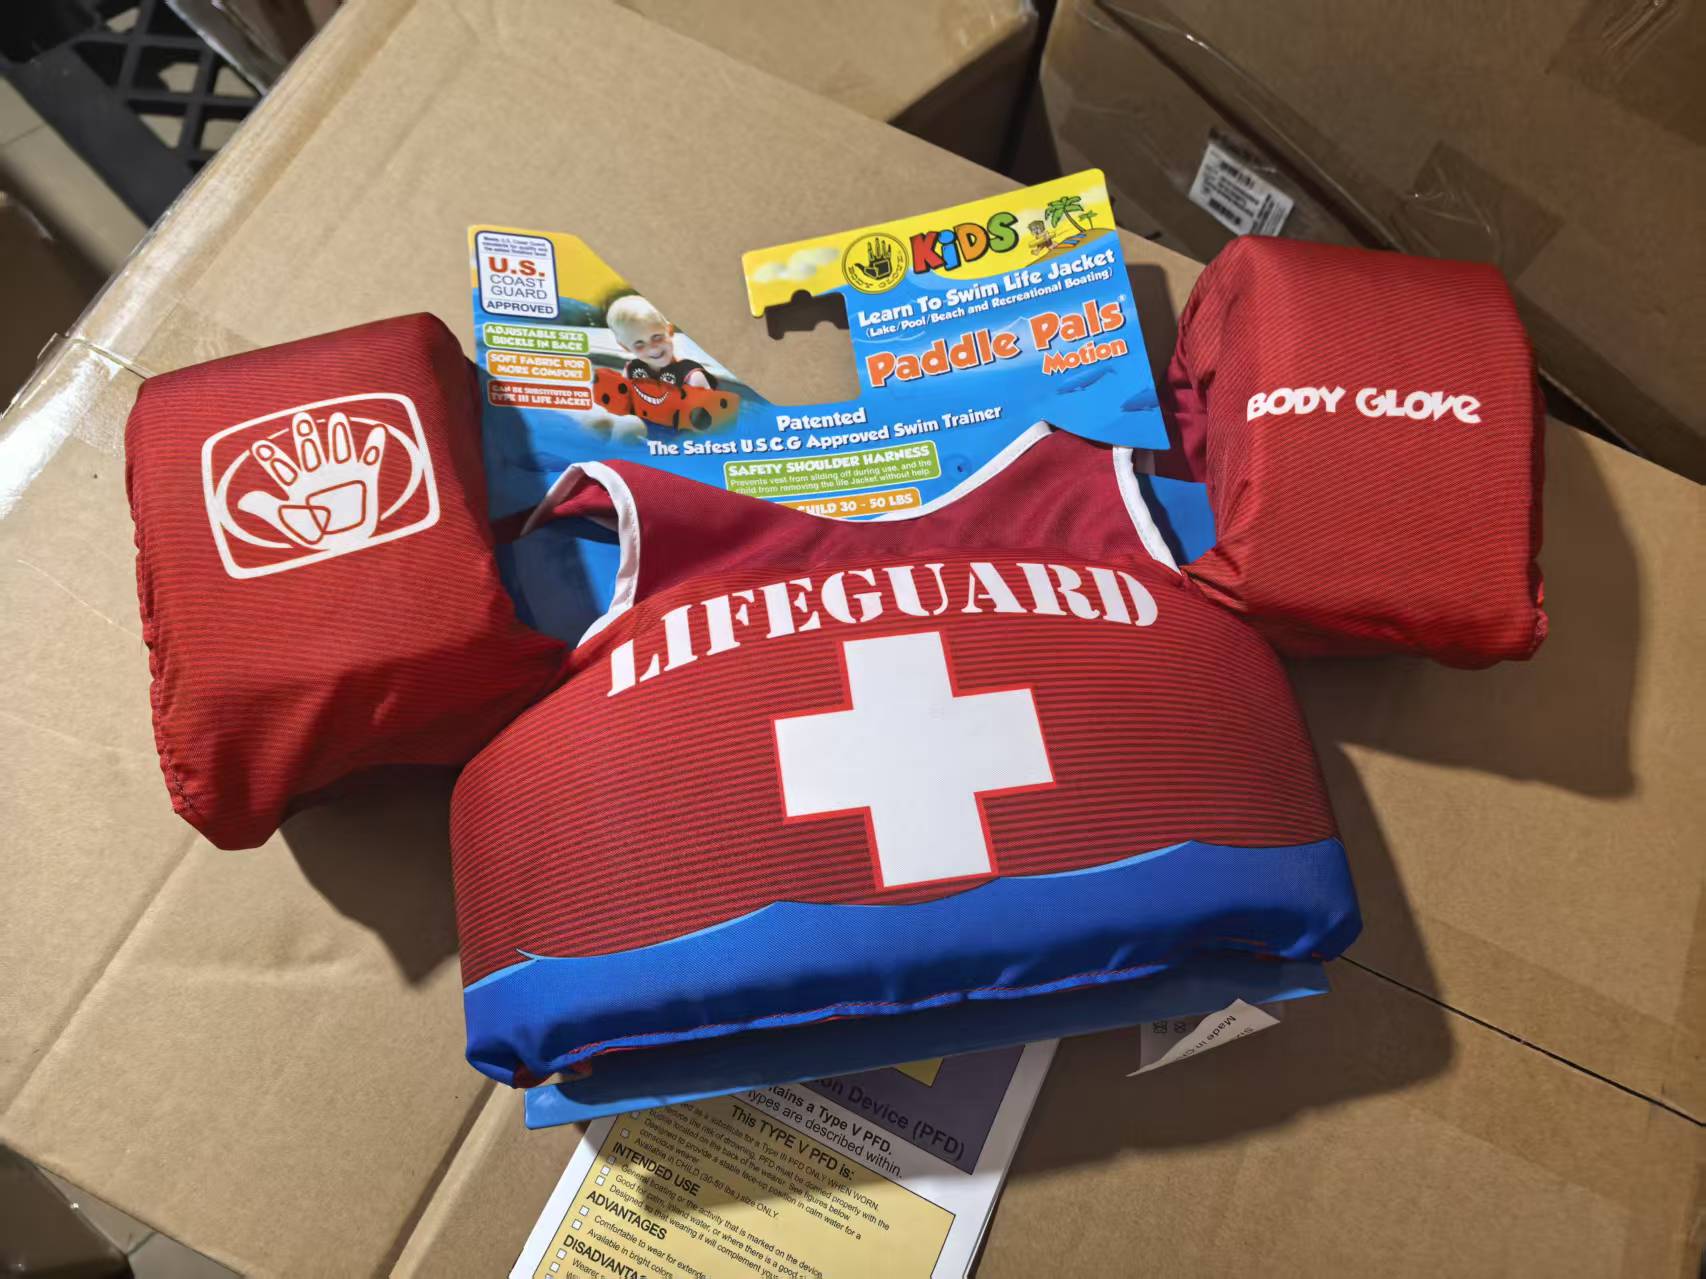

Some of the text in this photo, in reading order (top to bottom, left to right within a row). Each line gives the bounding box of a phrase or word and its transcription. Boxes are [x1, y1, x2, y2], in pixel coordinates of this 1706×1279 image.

[488, 256, 545, 277] U.S.
[490, 274, 546, 288] COAST
[858, 249, 1115, 327] Learn To Swim Life Jacket
[487, 300, 553, 314] APPROVED
[491, 285, 547, 300] GUARD
[968, 301, 989, 314] and
[992, 282, 1062, 308] Recreational
[1064, 267, 1113, 289] Boating)
[865, 328, 1022, 388] Paddle
[1042, 338, 1128, 375] Motion
[776, 407, 867, 431] Patented
[1247, 386, 1346, 422] BODY
[647, 440, 679, 456] The
[683, 440, 737, 456] Safest
[806, 425, 890, 449] Approved
[894, 419, 940, 437] Swim
[942, 405, 1003, 429] Trainer
[728, 445, 930, 477] SAFETY SHOULDER HARNESS
[839, 500, 857, 512] 30
[869, 496, 886, 509] 50
[889, 493, 914, 506] LBS
[606, 561, 1159, 697] LIFEGUARD
[1204, 1013, 1237, 1042] Made
[728, 1104, 856, 1181] This TYPE V PFD is:
[781, 1107, 803, 1124] are
[803, 1116, 866, 1156] described
[805, 1102, 816, 1113] a
[816, 1106, 850, 1132] Type
[848, 1123, 862, 1137] V
[846, 1085, 968, 1163] Device (PFD)
[610, 1141, 701, 1196] INTENDED USE
[585, 1189, 669, 1240] ADVANTAGES
[608, 1184, 762, 1273] Designed that wearing it will complement
[614, 1173, 636, 1190] Good
[635, 1184, 647, 1196] for
[711, 1228, 720, 1237] or
[720, 1232, 744, 1249] where
[743, 1245, 764, 1260] there
[763, 1255, 772, 1264] is
[771, 1260, 778, 1268] a
[776, 1263, 798, 1279] good
[619, 1162, 651, 1184] General
[648, 1179, 677, 1200] boating
[685, 1199, 698, 1210] the
[696, 1205, 725, 1226] activity
[723, 1219, 740, 1233] that
[738, 1227, 747, 1237] is
[745, 1232, 775, 1252] marked
[773, 1248, 785, 1258] on
[784, 1253, 799, 1265] the
[561, 1233, 647, 1279] DISADVANTA
[586, 1227, 652, 1269] Available in bright
[592, 1214, 677, 1265] Comfortable to wear for
